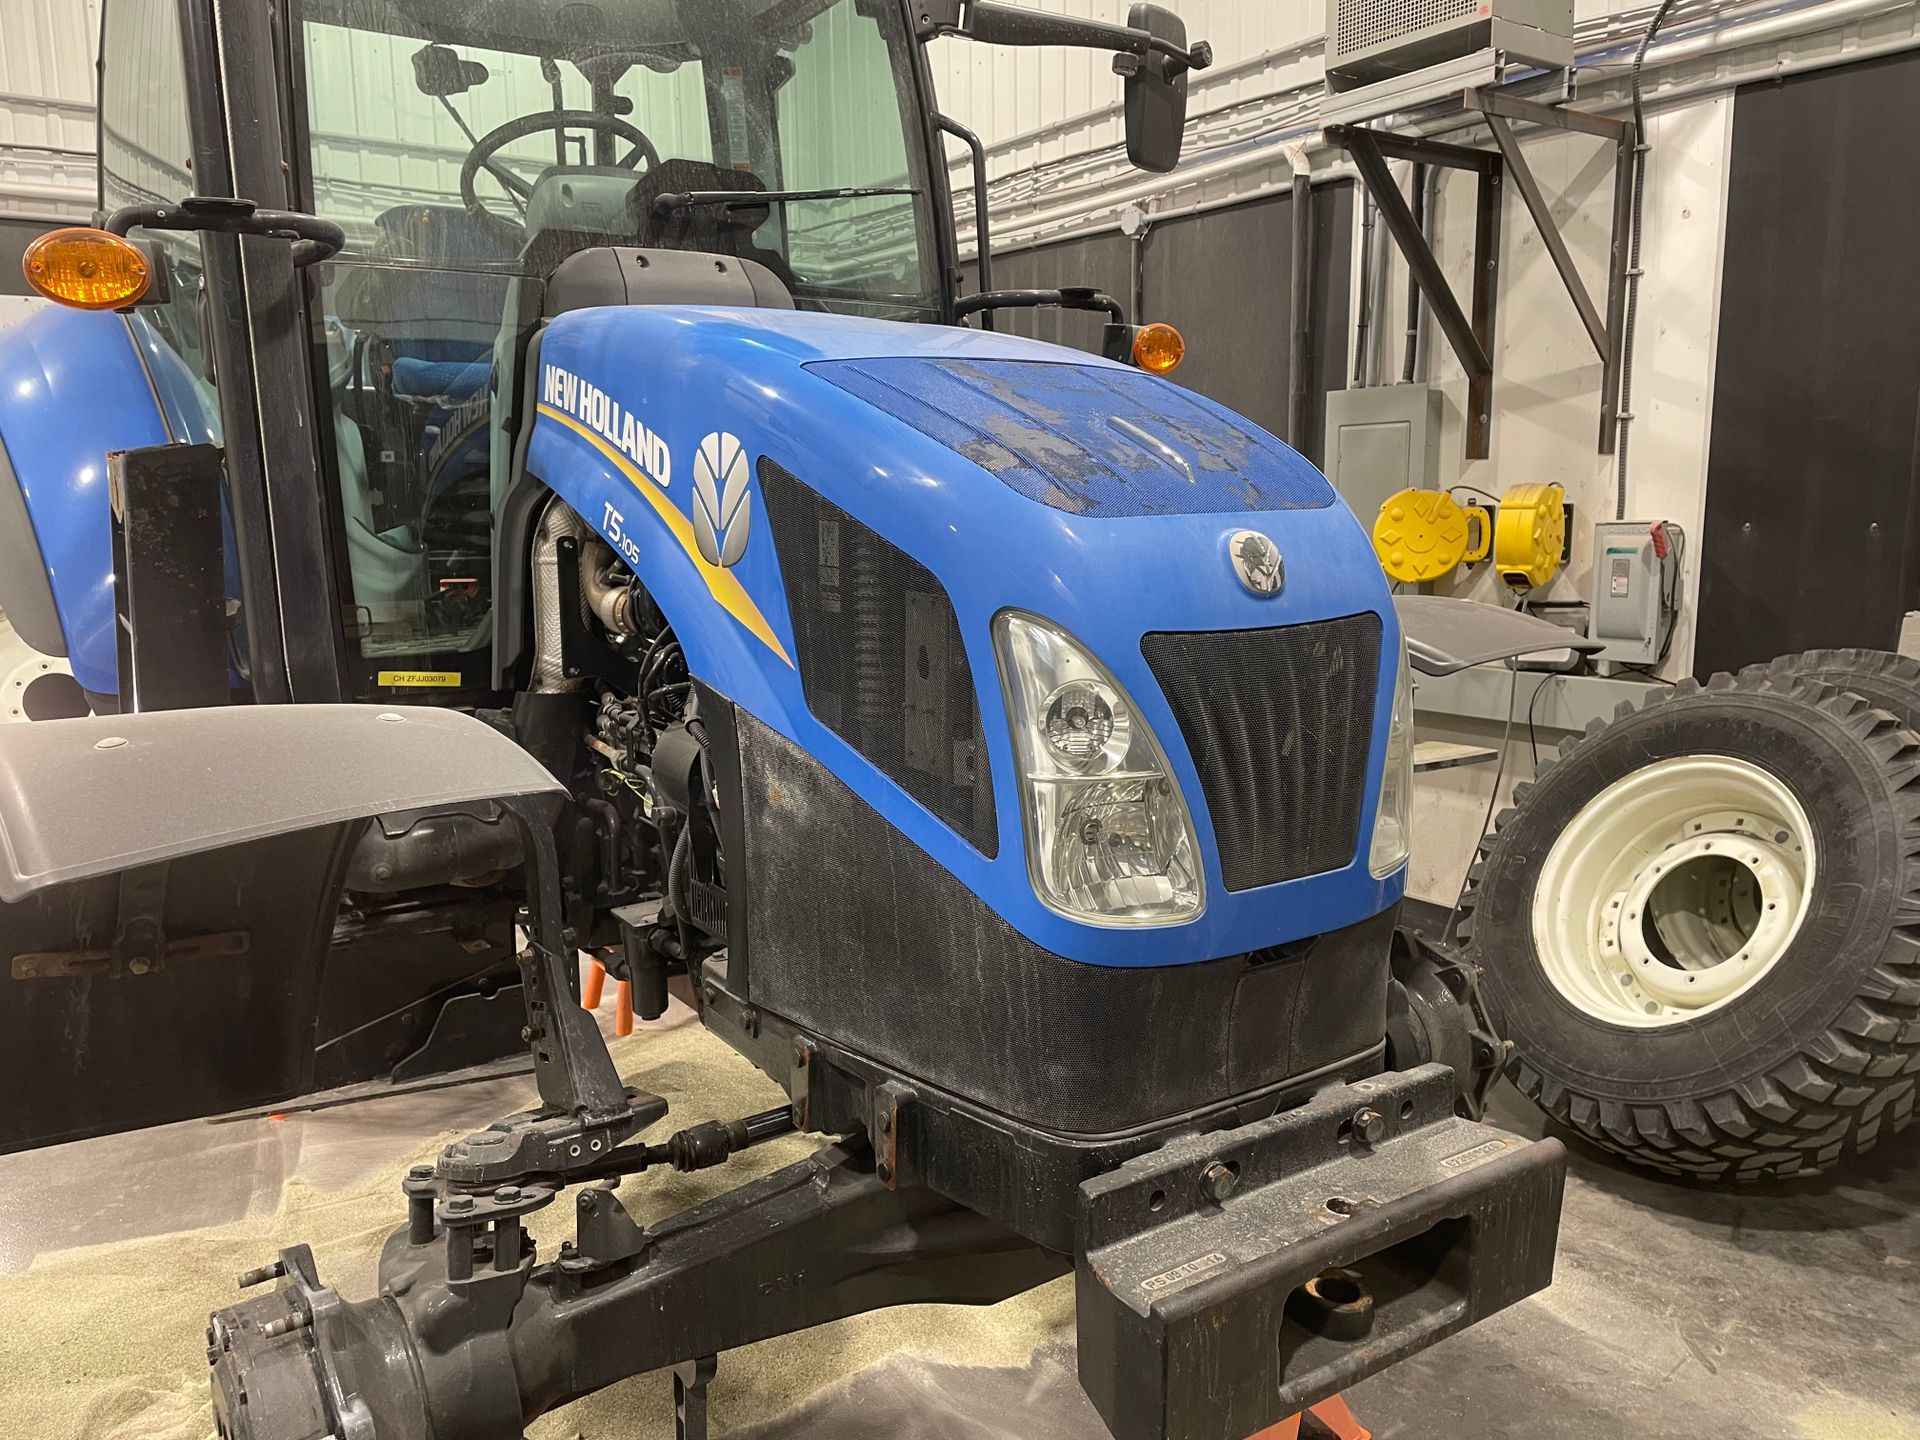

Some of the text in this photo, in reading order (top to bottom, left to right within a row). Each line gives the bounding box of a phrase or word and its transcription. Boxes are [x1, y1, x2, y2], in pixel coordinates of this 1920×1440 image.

[544, 364, 671, 488] NEW HOLLAND
[393, 675, 405, 683] CH
